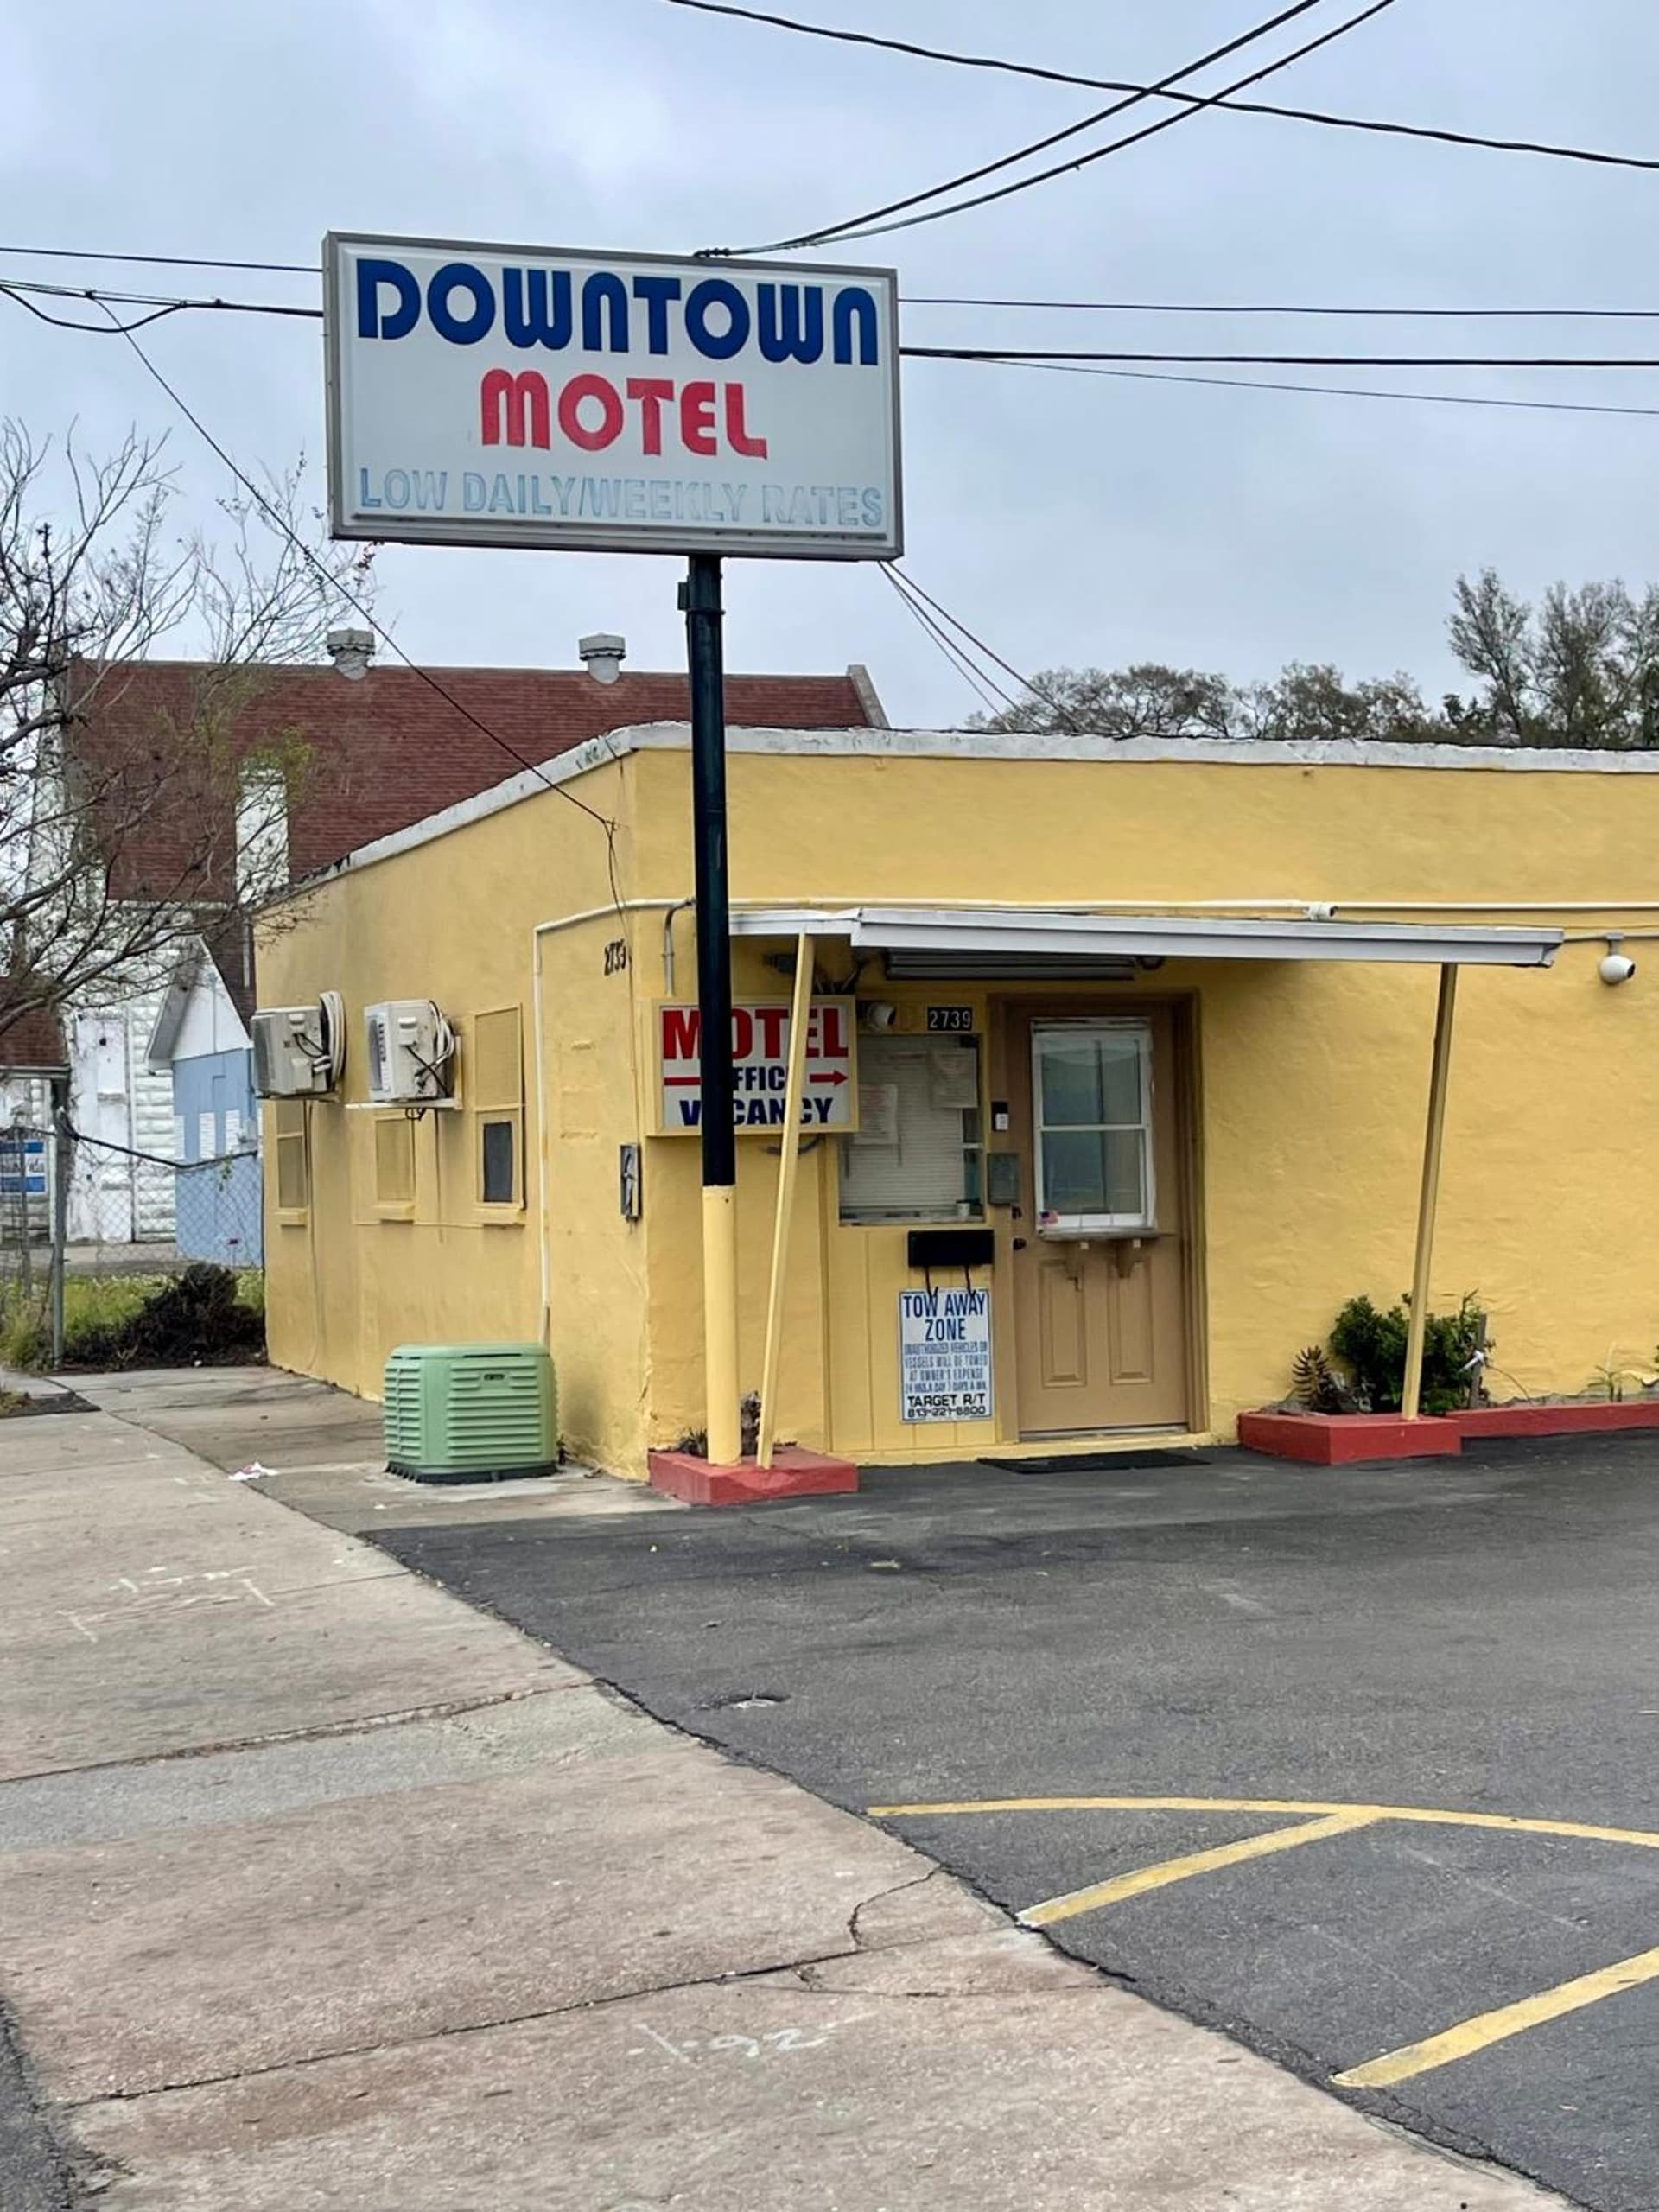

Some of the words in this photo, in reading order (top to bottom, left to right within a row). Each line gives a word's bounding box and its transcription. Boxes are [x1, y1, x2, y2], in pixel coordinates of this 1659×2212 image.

[357, 258, 878, 365] DOWNTOWN
[480, 368, 767, 460] MOTEL
[359, 467, 448, 510] LOW
[462, 473, 748, 524] DAILY/WEEKLY
[762, 484, 884, 528] RATES
[929, 1010, 971, 1029] 2739
[679, 1097, 834, 1126] VCANCY
[903, 1294, 938, 1318] TOW
[944, 1293, 986, 1316] AWAY
[925, 1318, 966, 1341] ZONE
[907, 1394, 957, 1408] TARGET
[963, 1393, 986, 1405] R/T
